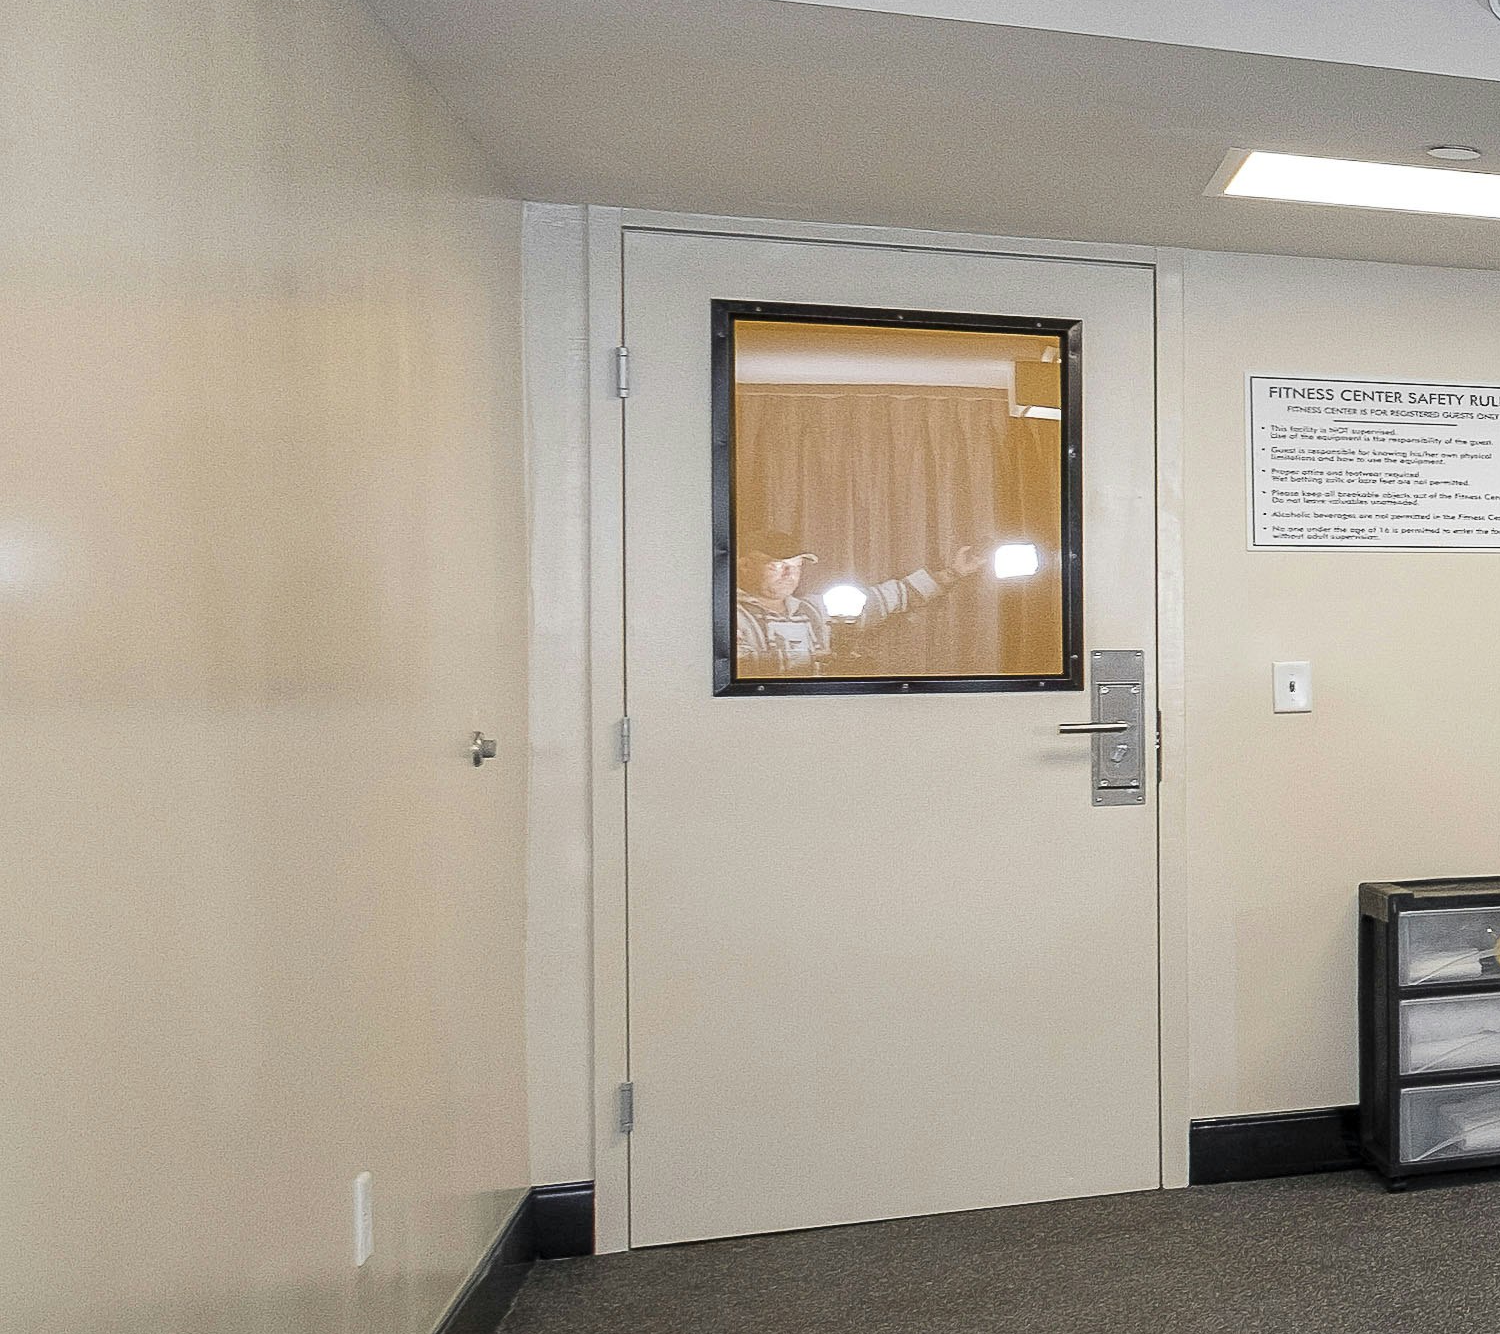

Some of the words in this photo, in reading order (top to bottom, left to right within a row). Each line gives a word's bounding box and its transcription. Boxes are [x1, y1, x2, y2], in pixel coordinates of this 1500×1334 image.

[1269, 386, 1334, 401] FITNESS
[1340, 389, 1404, 403] CENTER
[1408, 392, 1465, 406] SAFETY
[1287, 405, 1322, 414] FITNESS
[1324, 406, 1358, 415] CENTER
[1360, 408, 1368, 416] IS
